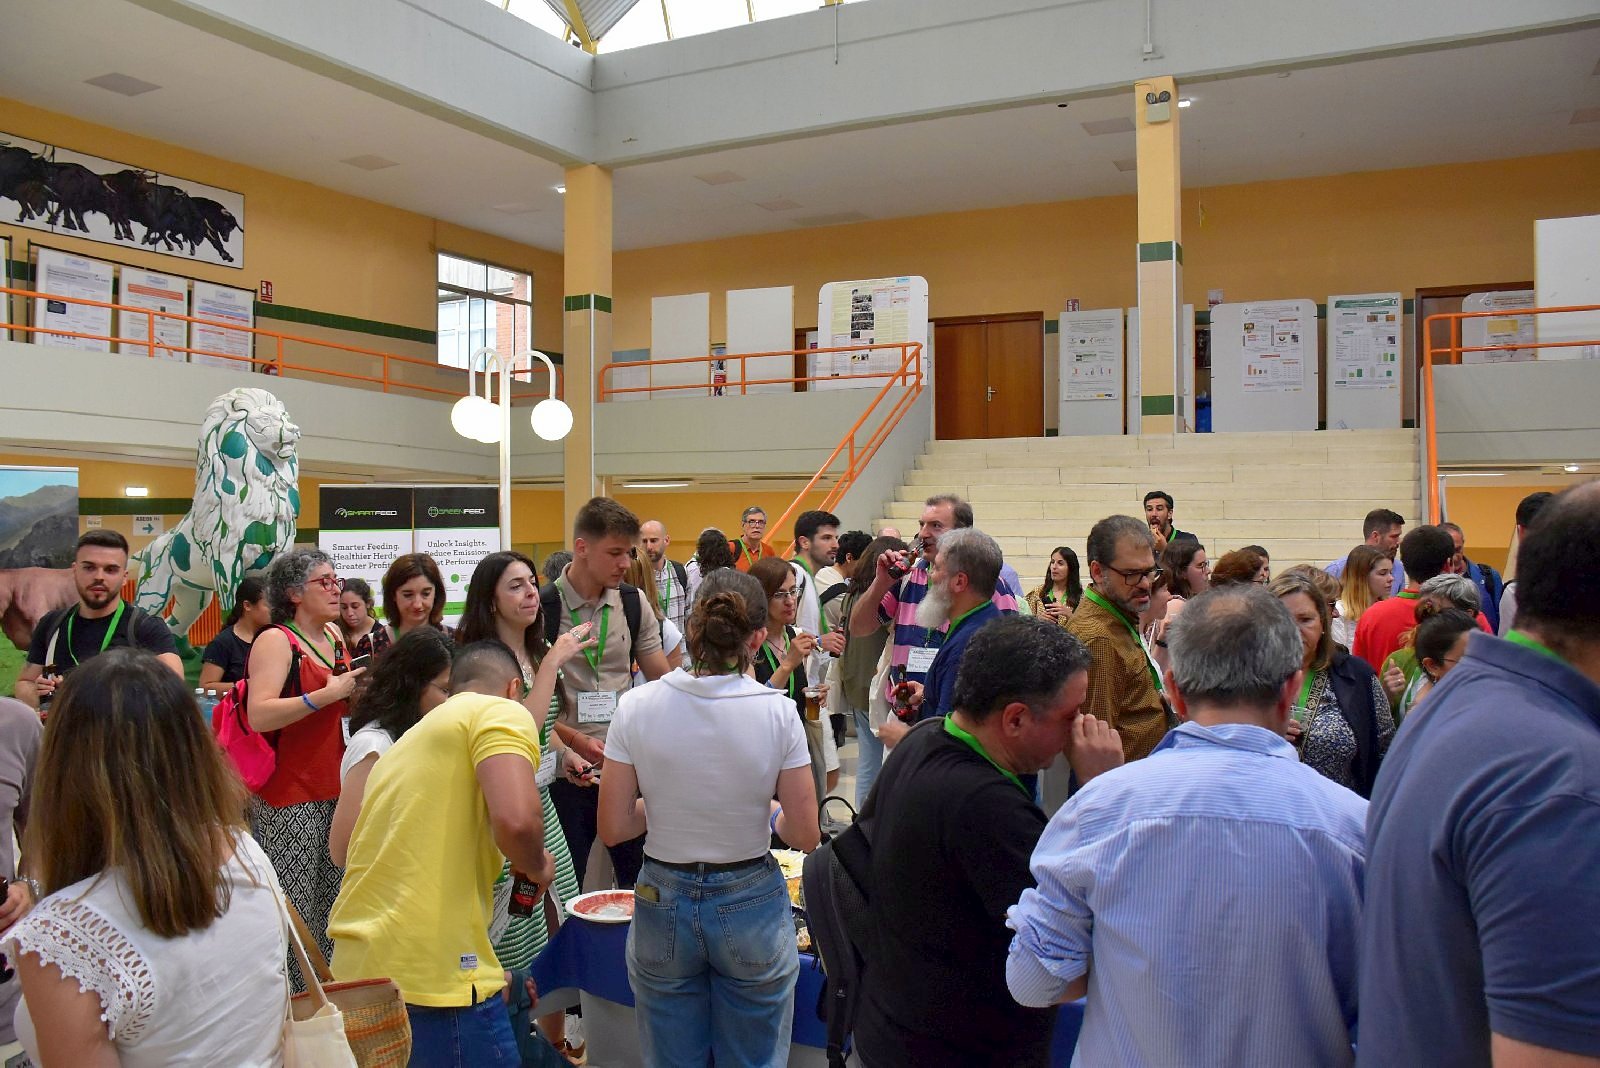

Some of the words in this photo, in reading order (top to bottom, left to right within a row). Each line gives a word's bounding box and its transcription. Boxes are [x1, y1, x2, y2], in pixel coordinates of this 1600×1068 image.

[367, 543, 400, 552] Feeding.
[454, 539, 487, 548] Insights.
[333, 552, 372, 561] Healthier
[335, 562, 366, 570] Greater
[368, 561, 391, 569] Profit
